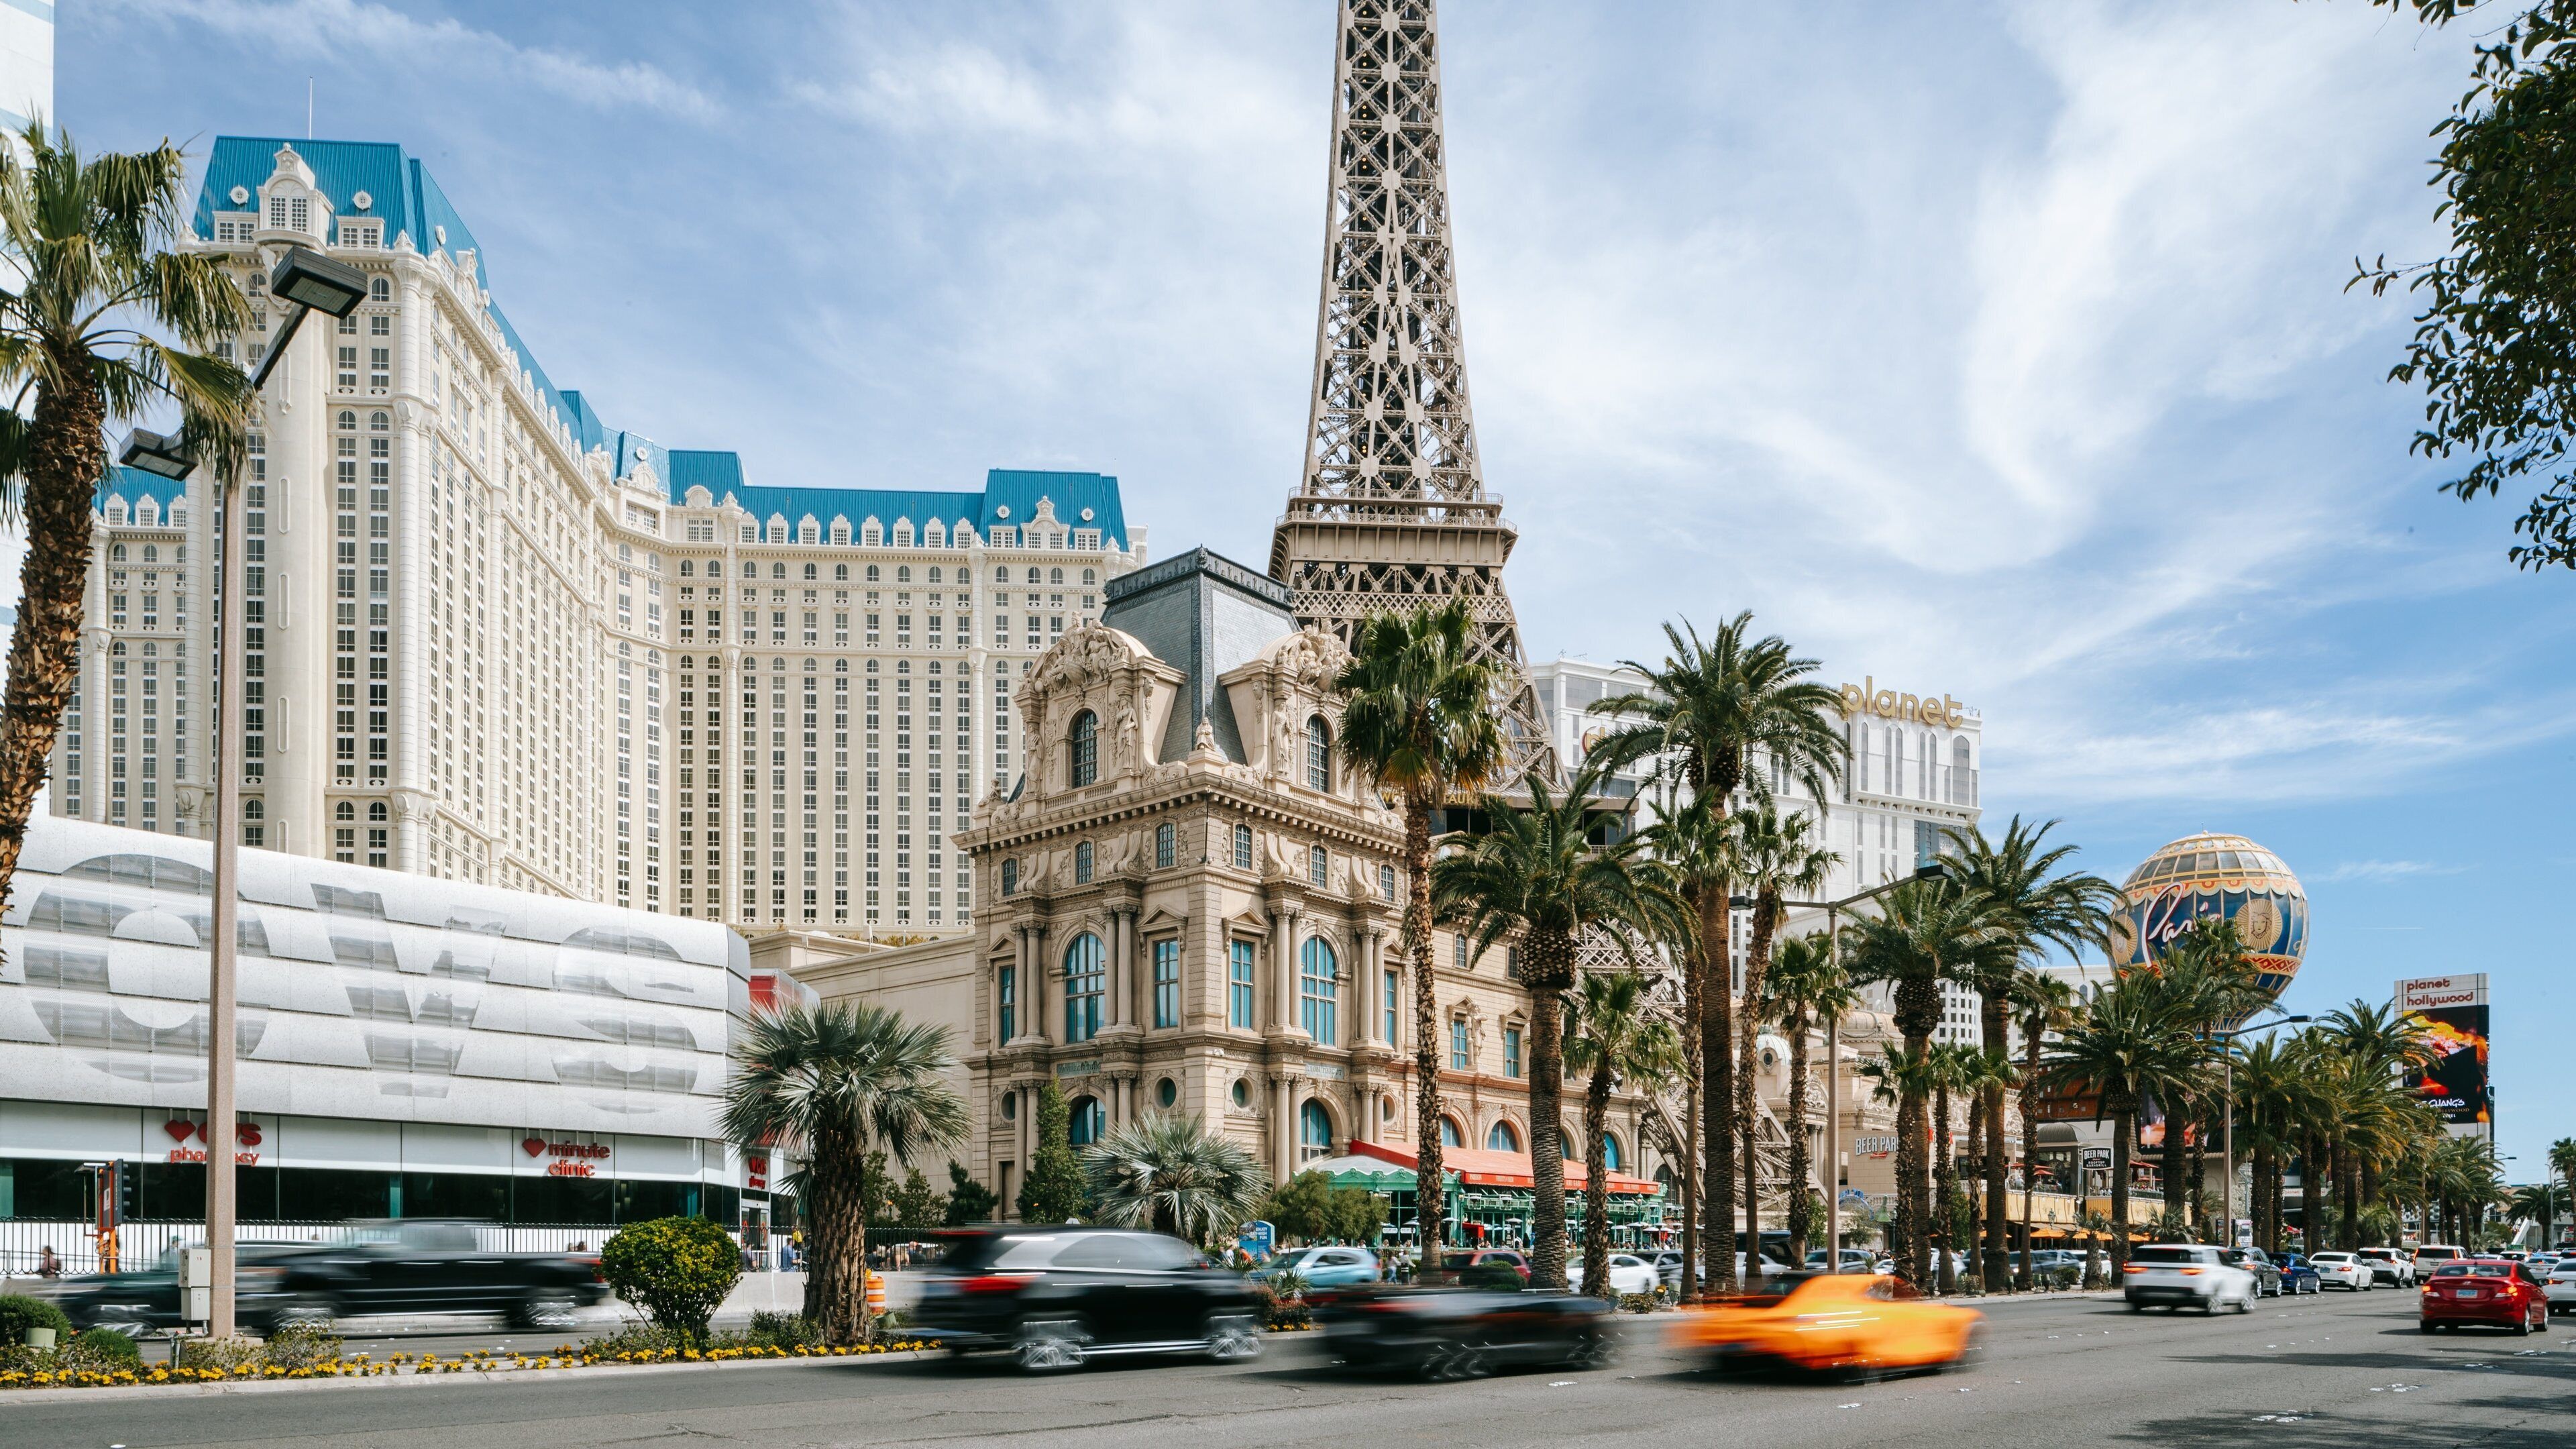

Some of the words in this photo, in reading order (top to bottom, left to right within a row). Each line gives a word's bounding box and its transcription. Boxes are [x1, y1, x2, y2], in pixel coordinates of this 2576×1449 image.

[1842, 676, 1963, 728] planet
[2141, 881, 2222, 968] Par
[23, 853, 700, 1115] CVS
[2407, 979, 2450, 994] planet
[2407, 991, 2473, 1007] hollywood
[2428, 1098, 2465, 1108] CHANG'S
[548, 1140, 610, 1159] minute
[1856, 1136, 1878, 1156] BEER
[2084, 1150, 2096, 1160] BEER
[2097, 1149, 2109, 1159] PARK
[548, 1159, 596, 1176] clinic
